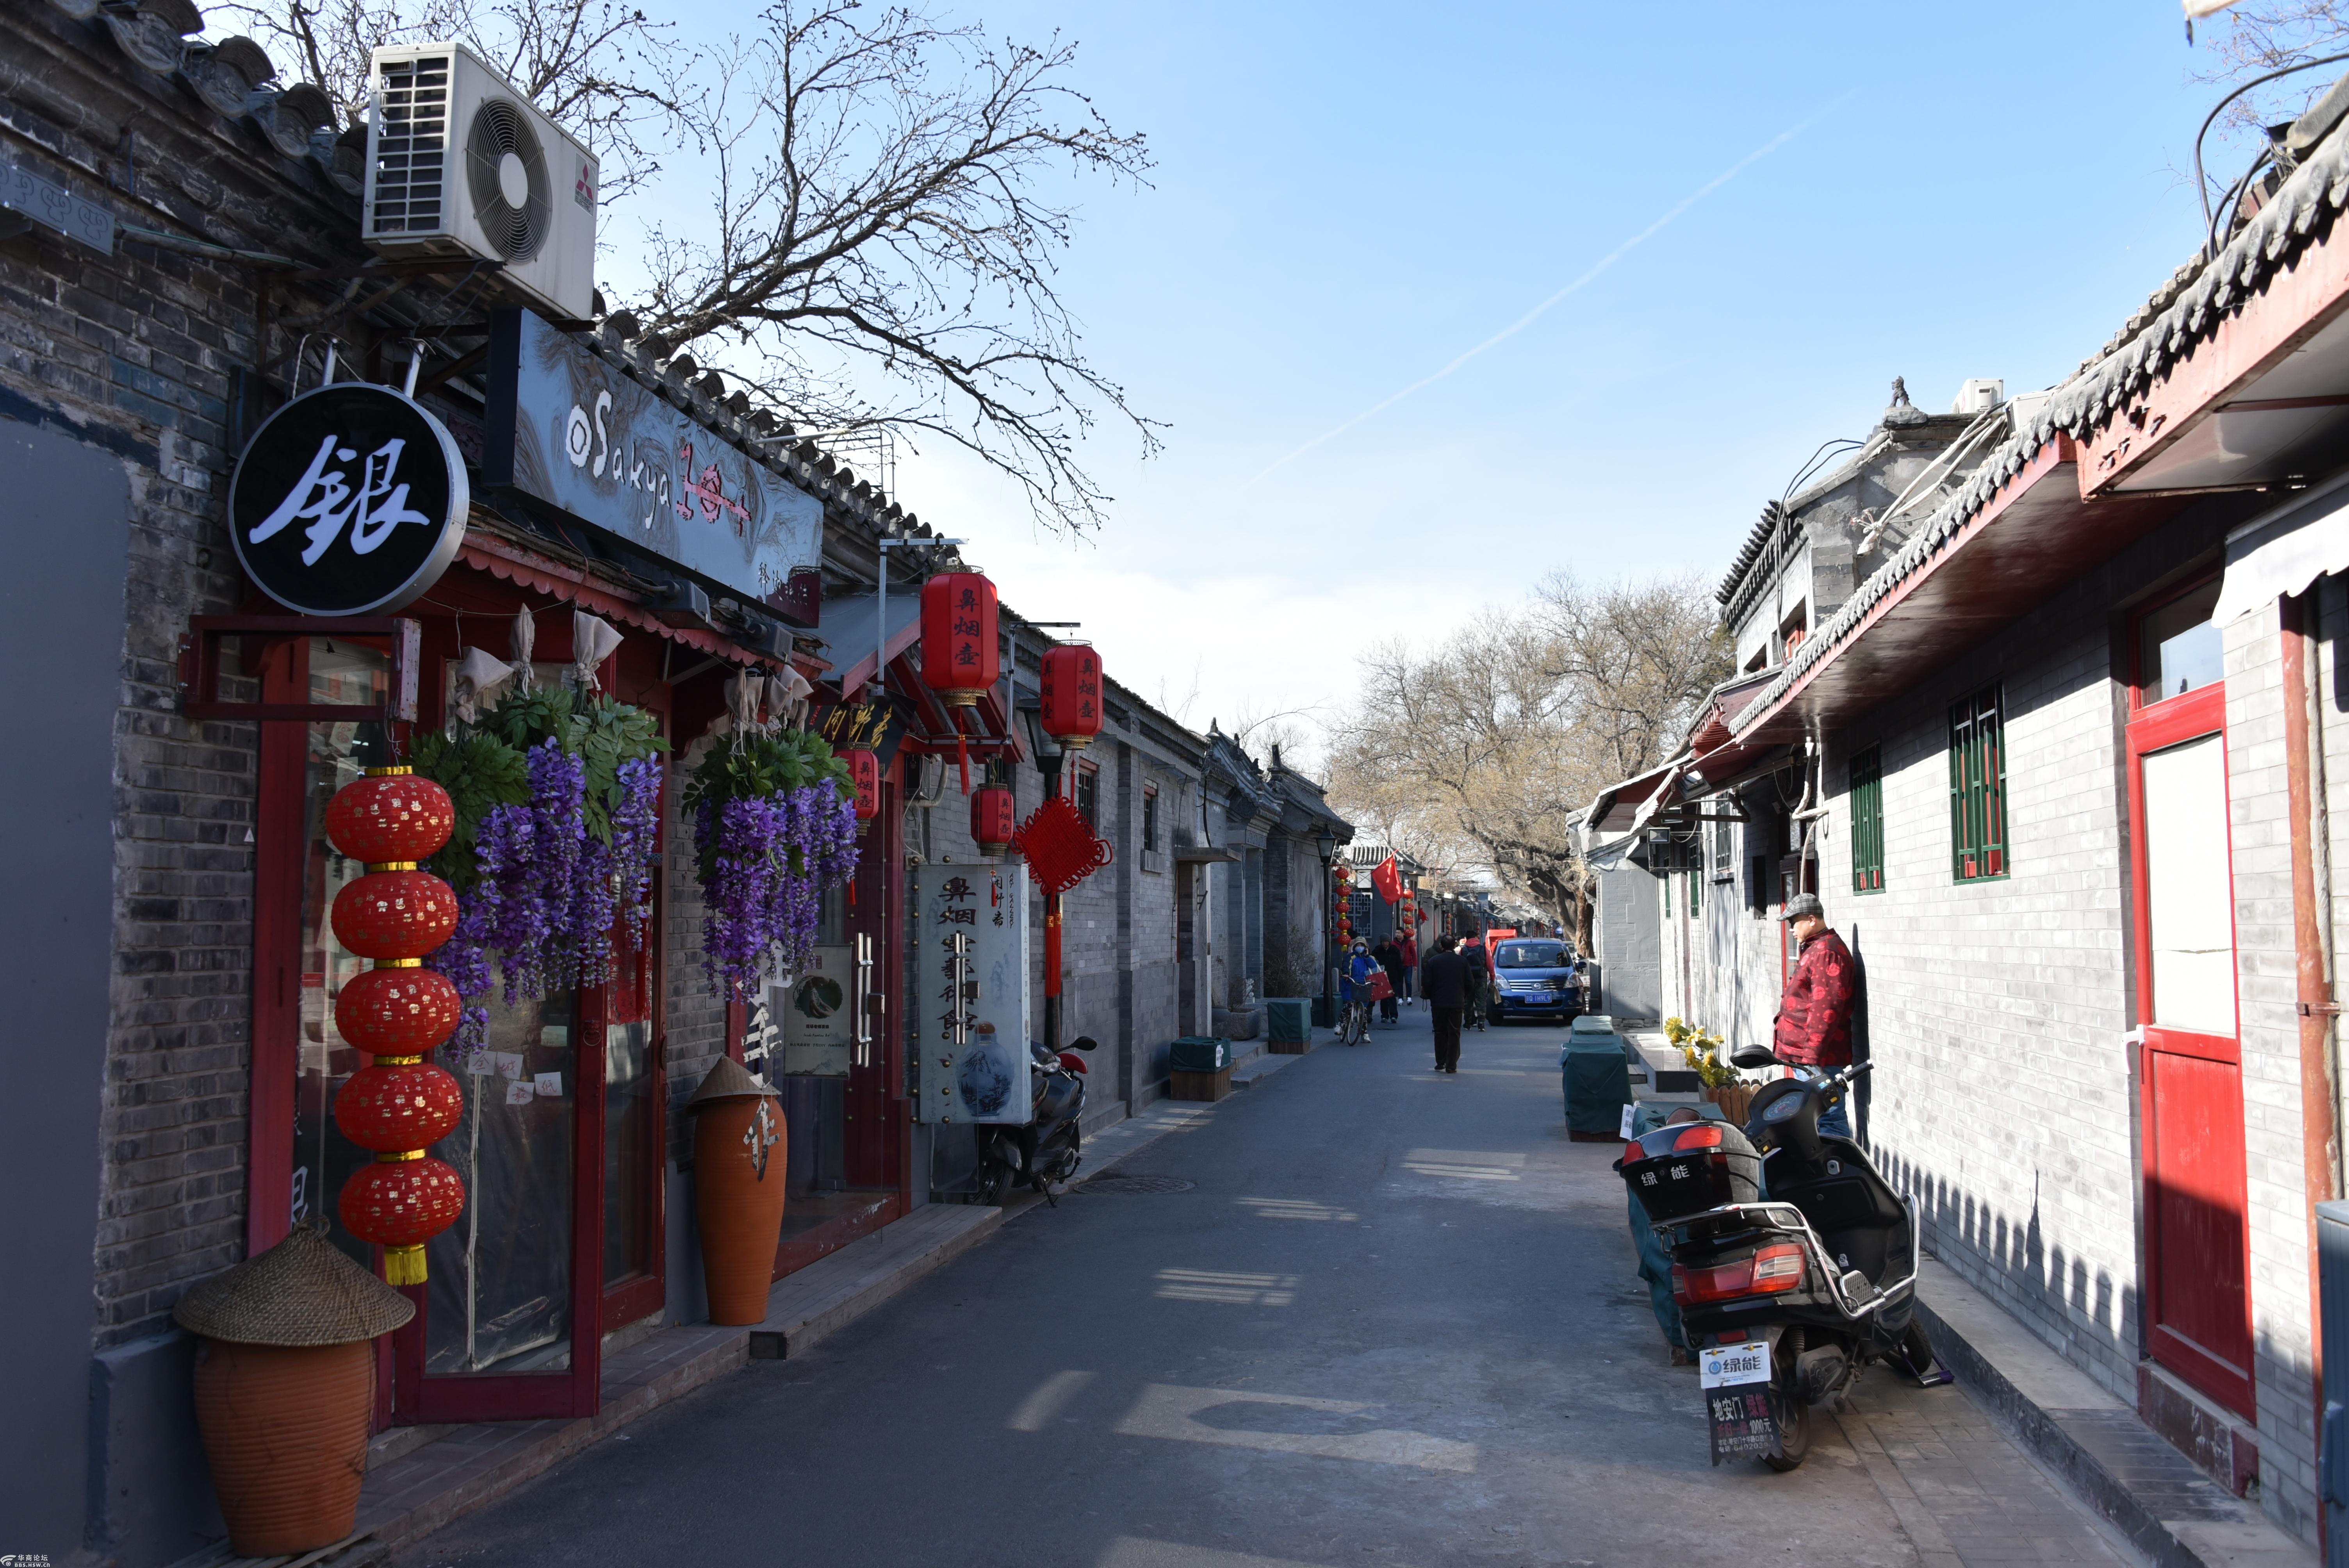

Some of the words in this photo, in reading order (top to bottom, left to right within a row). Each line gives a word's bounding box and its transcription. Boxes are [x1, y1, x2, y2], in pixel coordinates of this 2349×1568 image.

[575, 196, 591, 212] ELECTRIC
[576, 188, 593, 208] MITSUBISHI
[954, 588, 980, 665] 鼻烟壶
[1078, 658, 1096, 718] 鼻烟壶
[857, 761, 873, 808] 鼻烟壶
[999, 798, 1010, 834] 鼻烟壶
[1641, 1165, 1690, 1186] 绿能
[1723, 1356, 1761, 1373] 绿能
[1713, 1397, 1744, 1421] 地安门
[1749, 1418, 1772, 1434] 1000元
